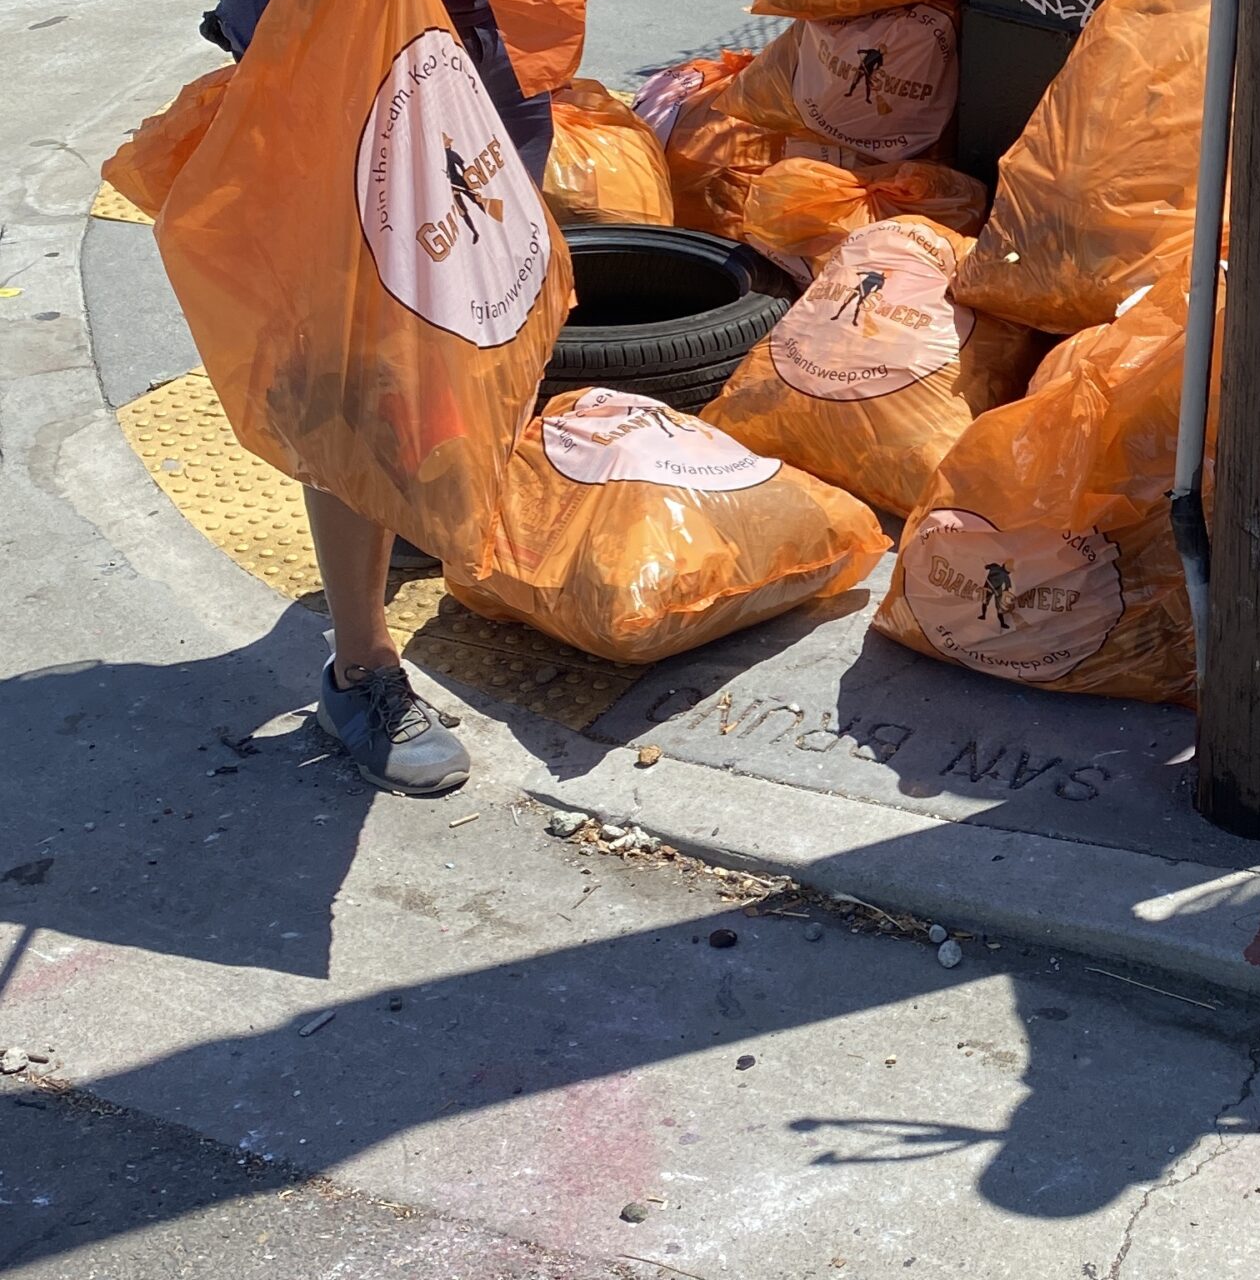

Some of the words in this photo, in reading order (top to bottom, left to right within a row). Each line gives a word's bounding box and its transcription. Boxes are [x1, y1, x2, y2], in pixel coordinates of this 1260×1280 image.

[918, 14, 937, 27] SF
[817, 39, 860, 83] GIANT
[868, 69, 933, 101] SWEEP
[803, 96, 908, 152] sfgiantsweep.org
[463, 132, 506, 191] SEE
[907, 228, 939, 257] Keep
[859, 292, 933, 331] SWEEP
[784, 337, 889, 385] sfgiantsweep.org
[927, 553, 988, 604] GIANT
[999, 586, 1081, 613] SWEEP
